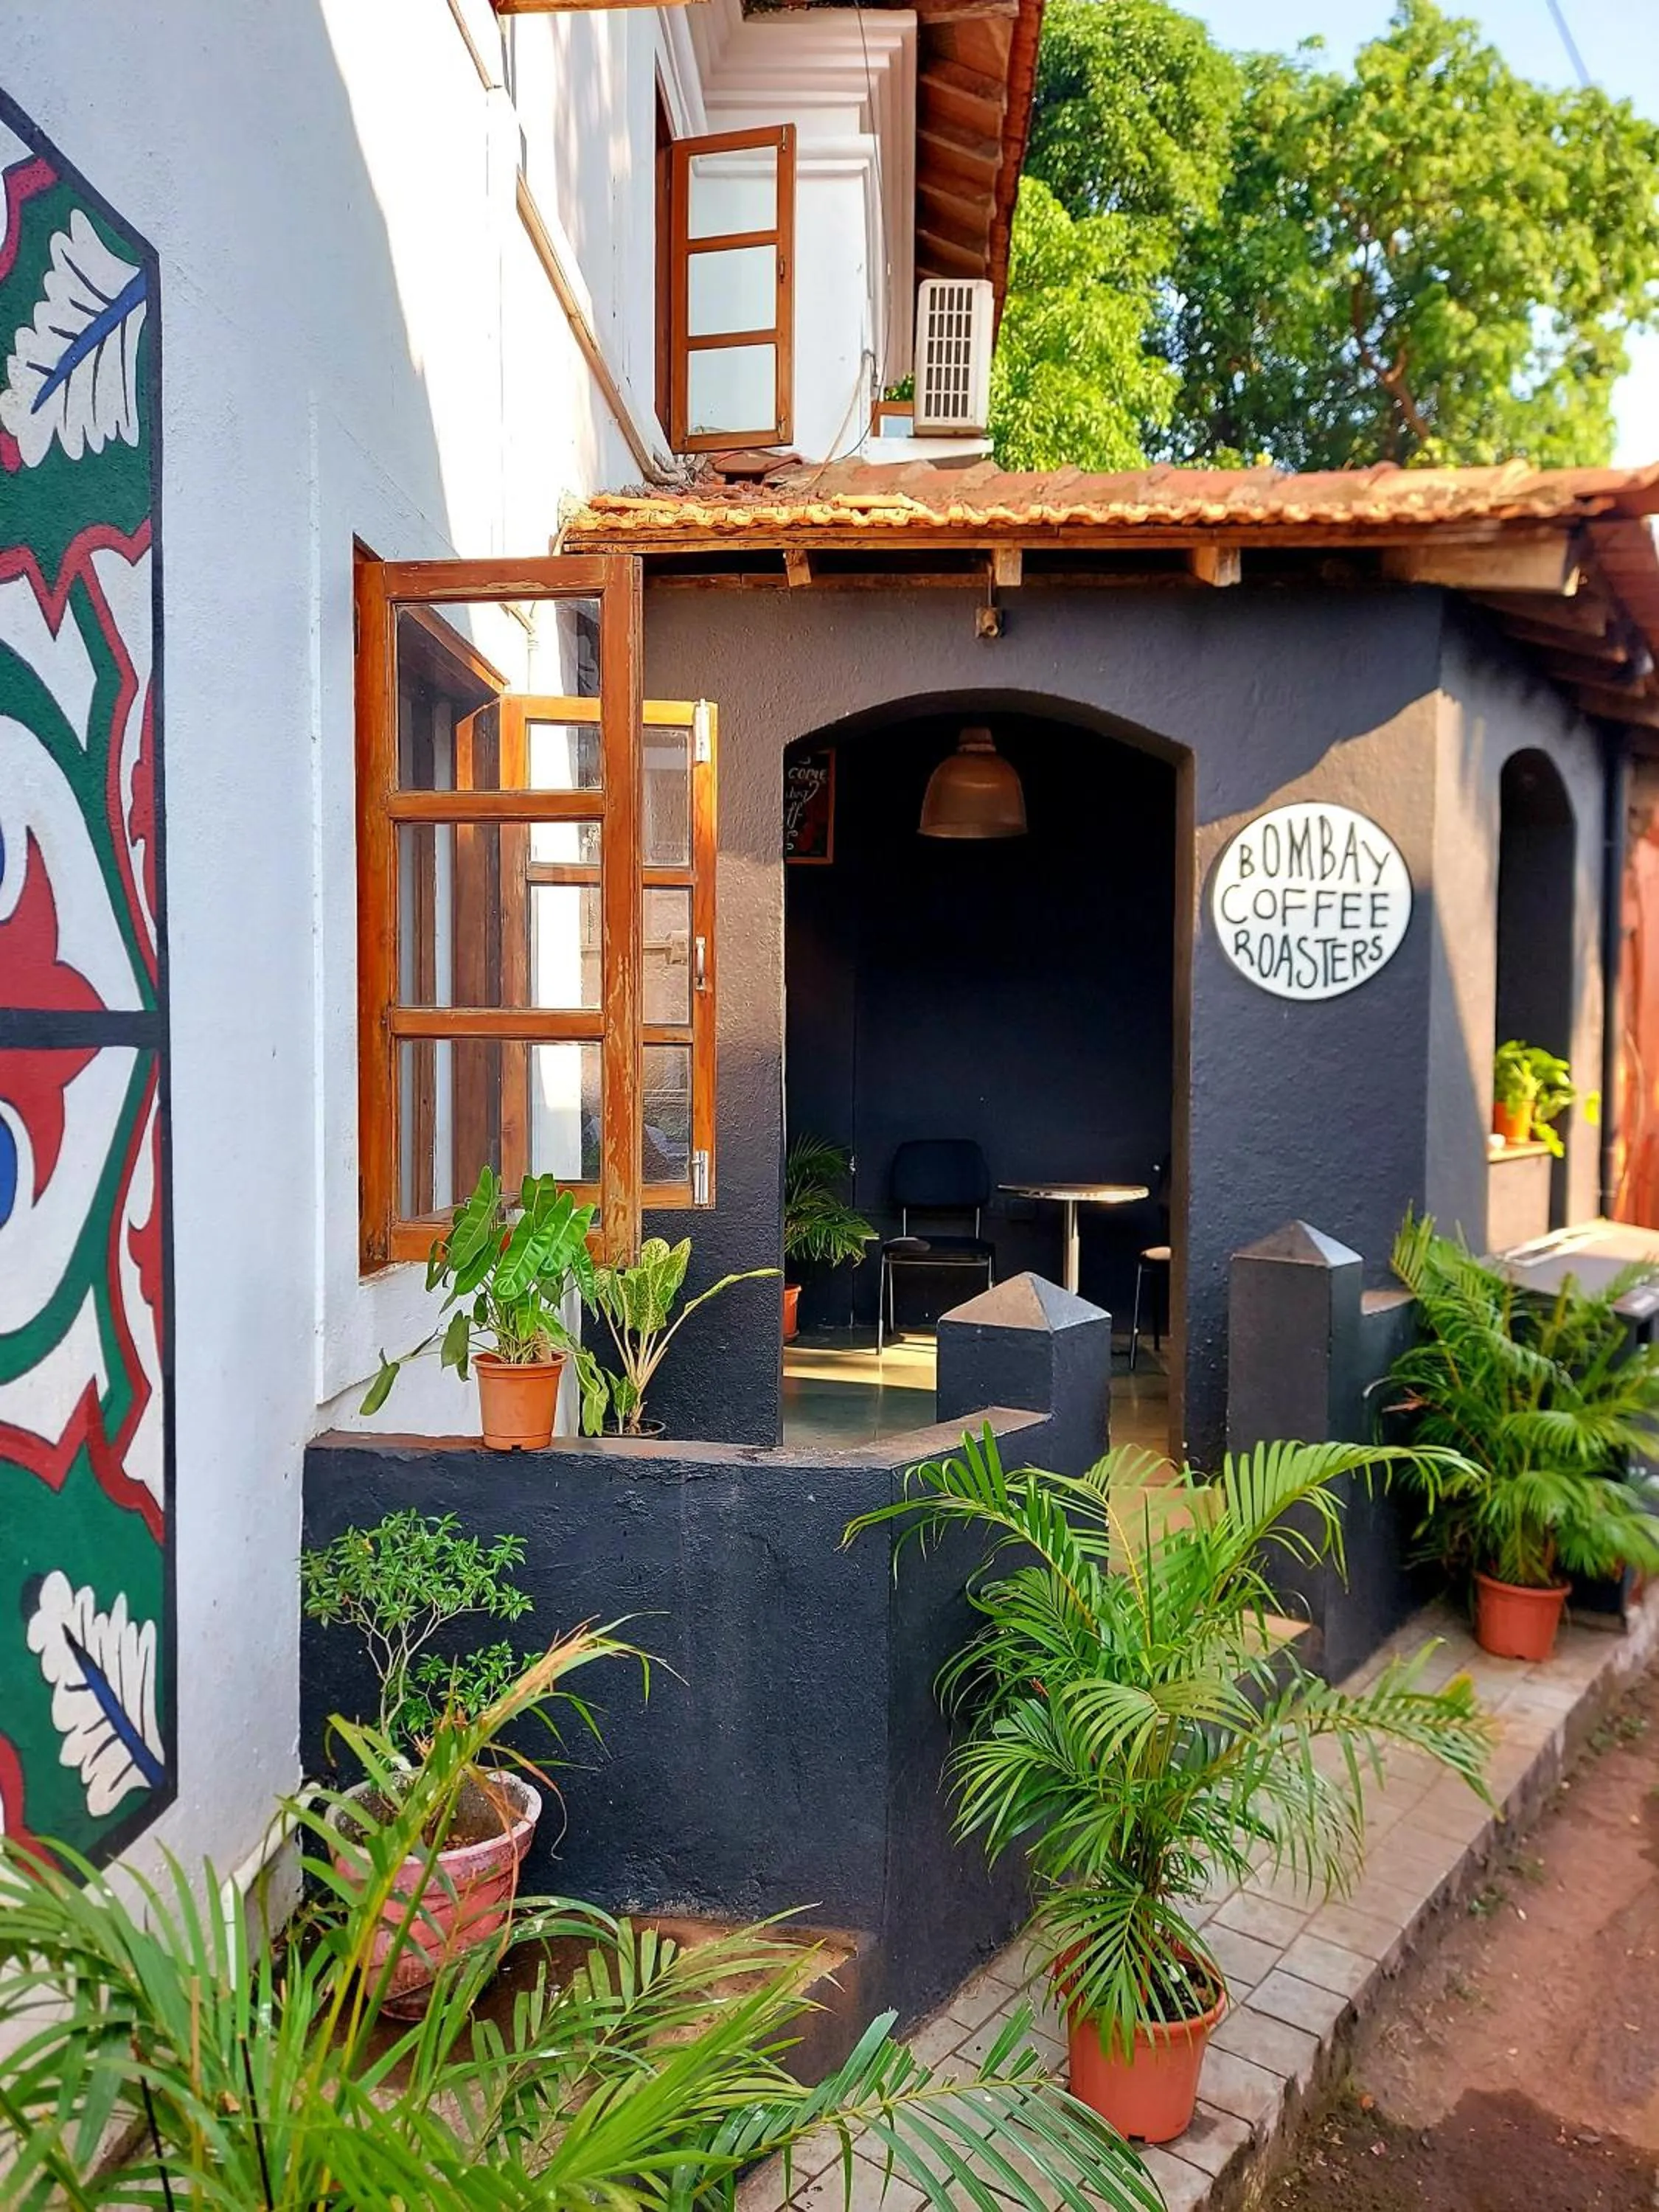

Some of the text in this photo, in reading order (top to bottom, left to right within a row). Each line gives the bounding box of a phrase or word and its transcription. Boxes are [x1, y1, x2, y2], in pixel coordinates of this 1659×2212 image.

[1239, 815, 1391, 886] BOMBAY
[1220, 884, 1390, 930] COFFEE
[1234, 929, 1383, 989] ROASTERS
